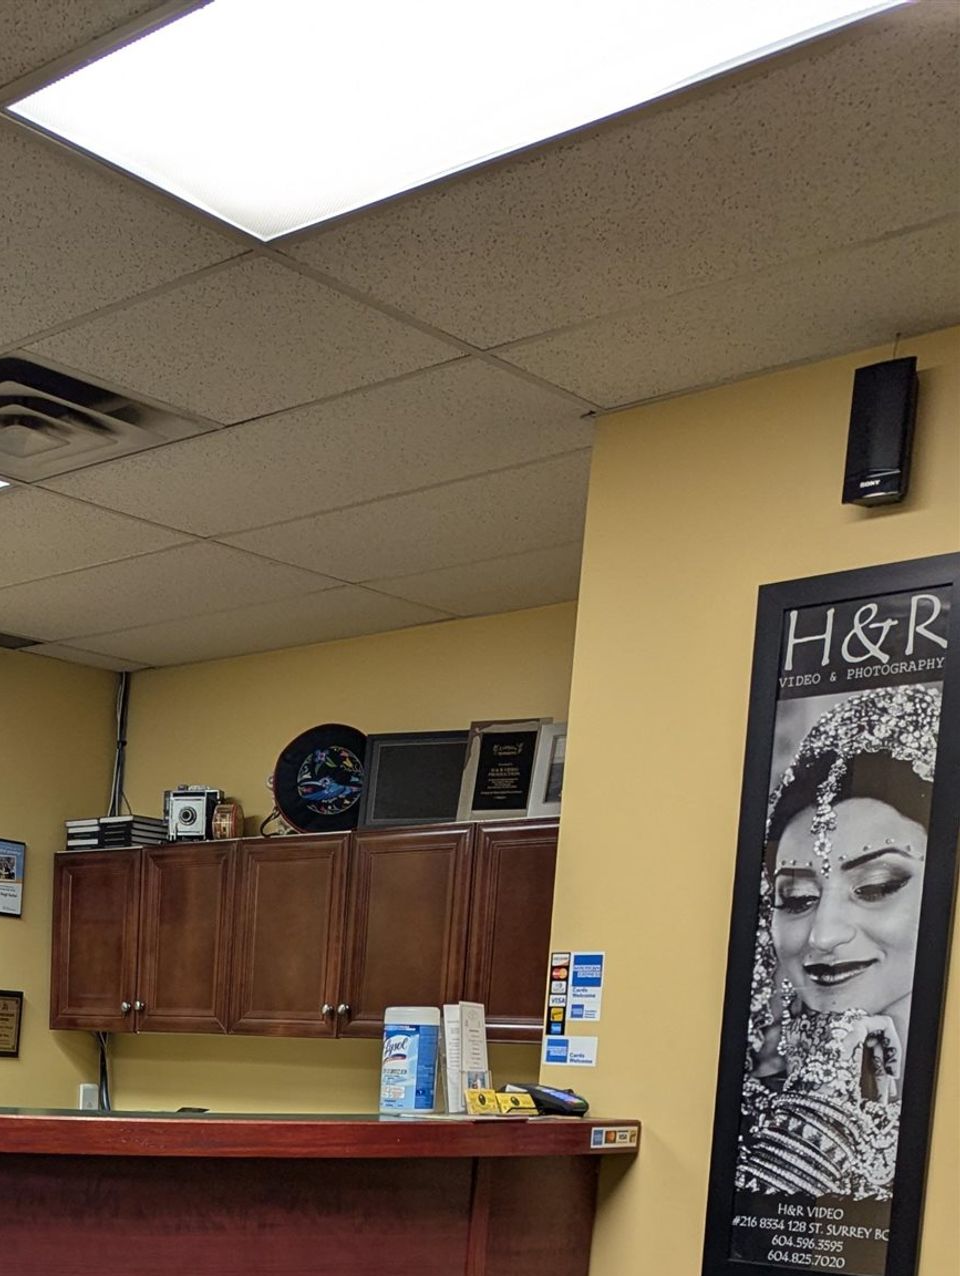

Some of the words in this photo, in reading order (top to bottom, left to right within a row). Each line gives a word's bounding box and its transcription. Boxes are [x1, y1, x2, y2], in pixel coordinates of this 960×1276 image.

[859, 479, 881, 488] SONY
[784, 594, 948, 671] H&R
[779, 673, 821, 687] VIDEO
[829, 671, 837, 682] &
[846, 657, 944, 680] PHOTOGRAPHY
[778, 1203, 804, 1217] H&R
[806, 1206, 844, 1220] VIDEO
[731, 1216, 758, 1228] #216
[787, 1220, 807, 1233] 128
[808, 1223, 824, 1235] ST.
[826, 1224, 873, 1239] SURREY
[874, 1229, 890, 1241] BC
[771, 1234, 844, 1253] 604.596.3595
[767, 1250, 846, 1269] 604.825.7020
